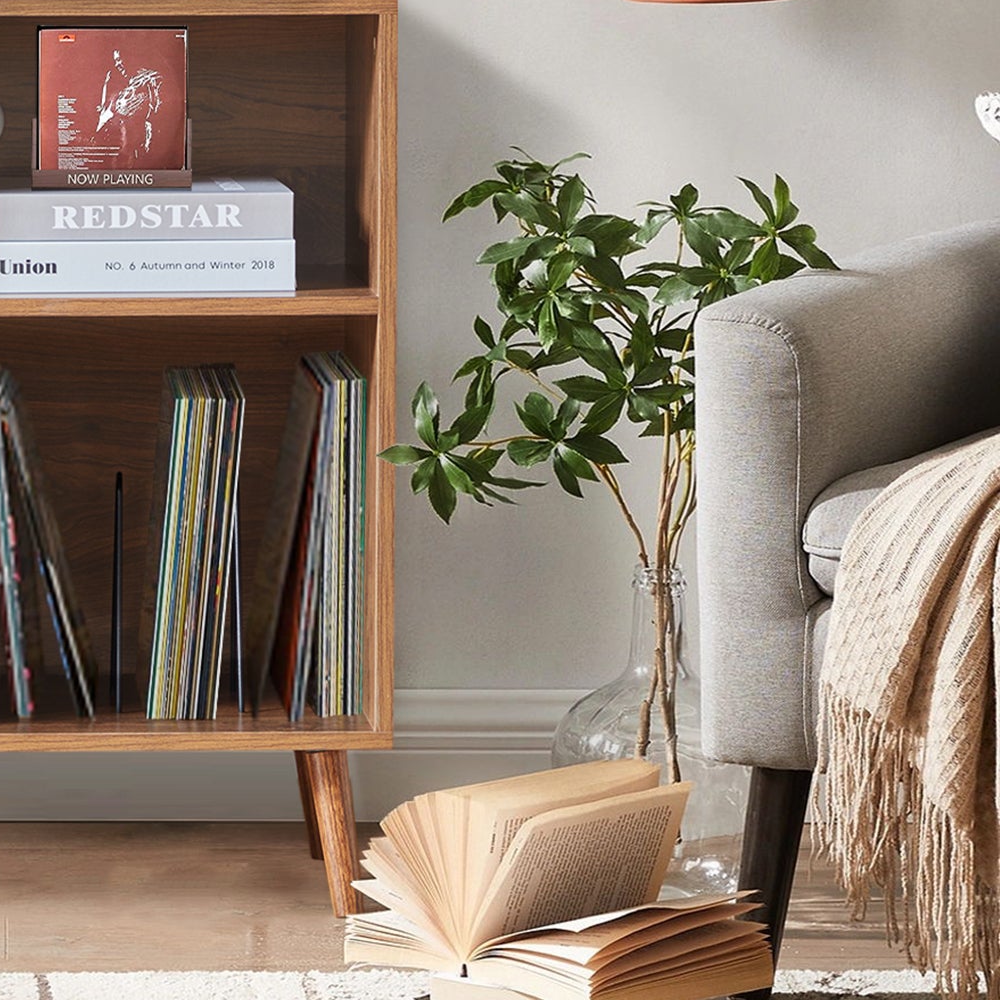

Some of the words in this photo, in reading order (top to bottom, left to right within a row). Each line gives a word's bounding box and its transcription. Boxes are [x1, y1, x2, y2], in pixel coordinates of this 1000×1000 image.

[67, 174, 100, 185] NOW
[104, 174, 154, 185] PLAYING
[52, 204, 243, 230] REDSTAR
[0, 259, 58, 275] Union
[105, 261, 124, 271] NO.
[129, 261, 137, 271] 6
[140, 261, 182, 271] Autumn
[184, 261, 206, 271] and
[210, 260, 246, 271] Winter
[251, 260, 275, 271] 2018
